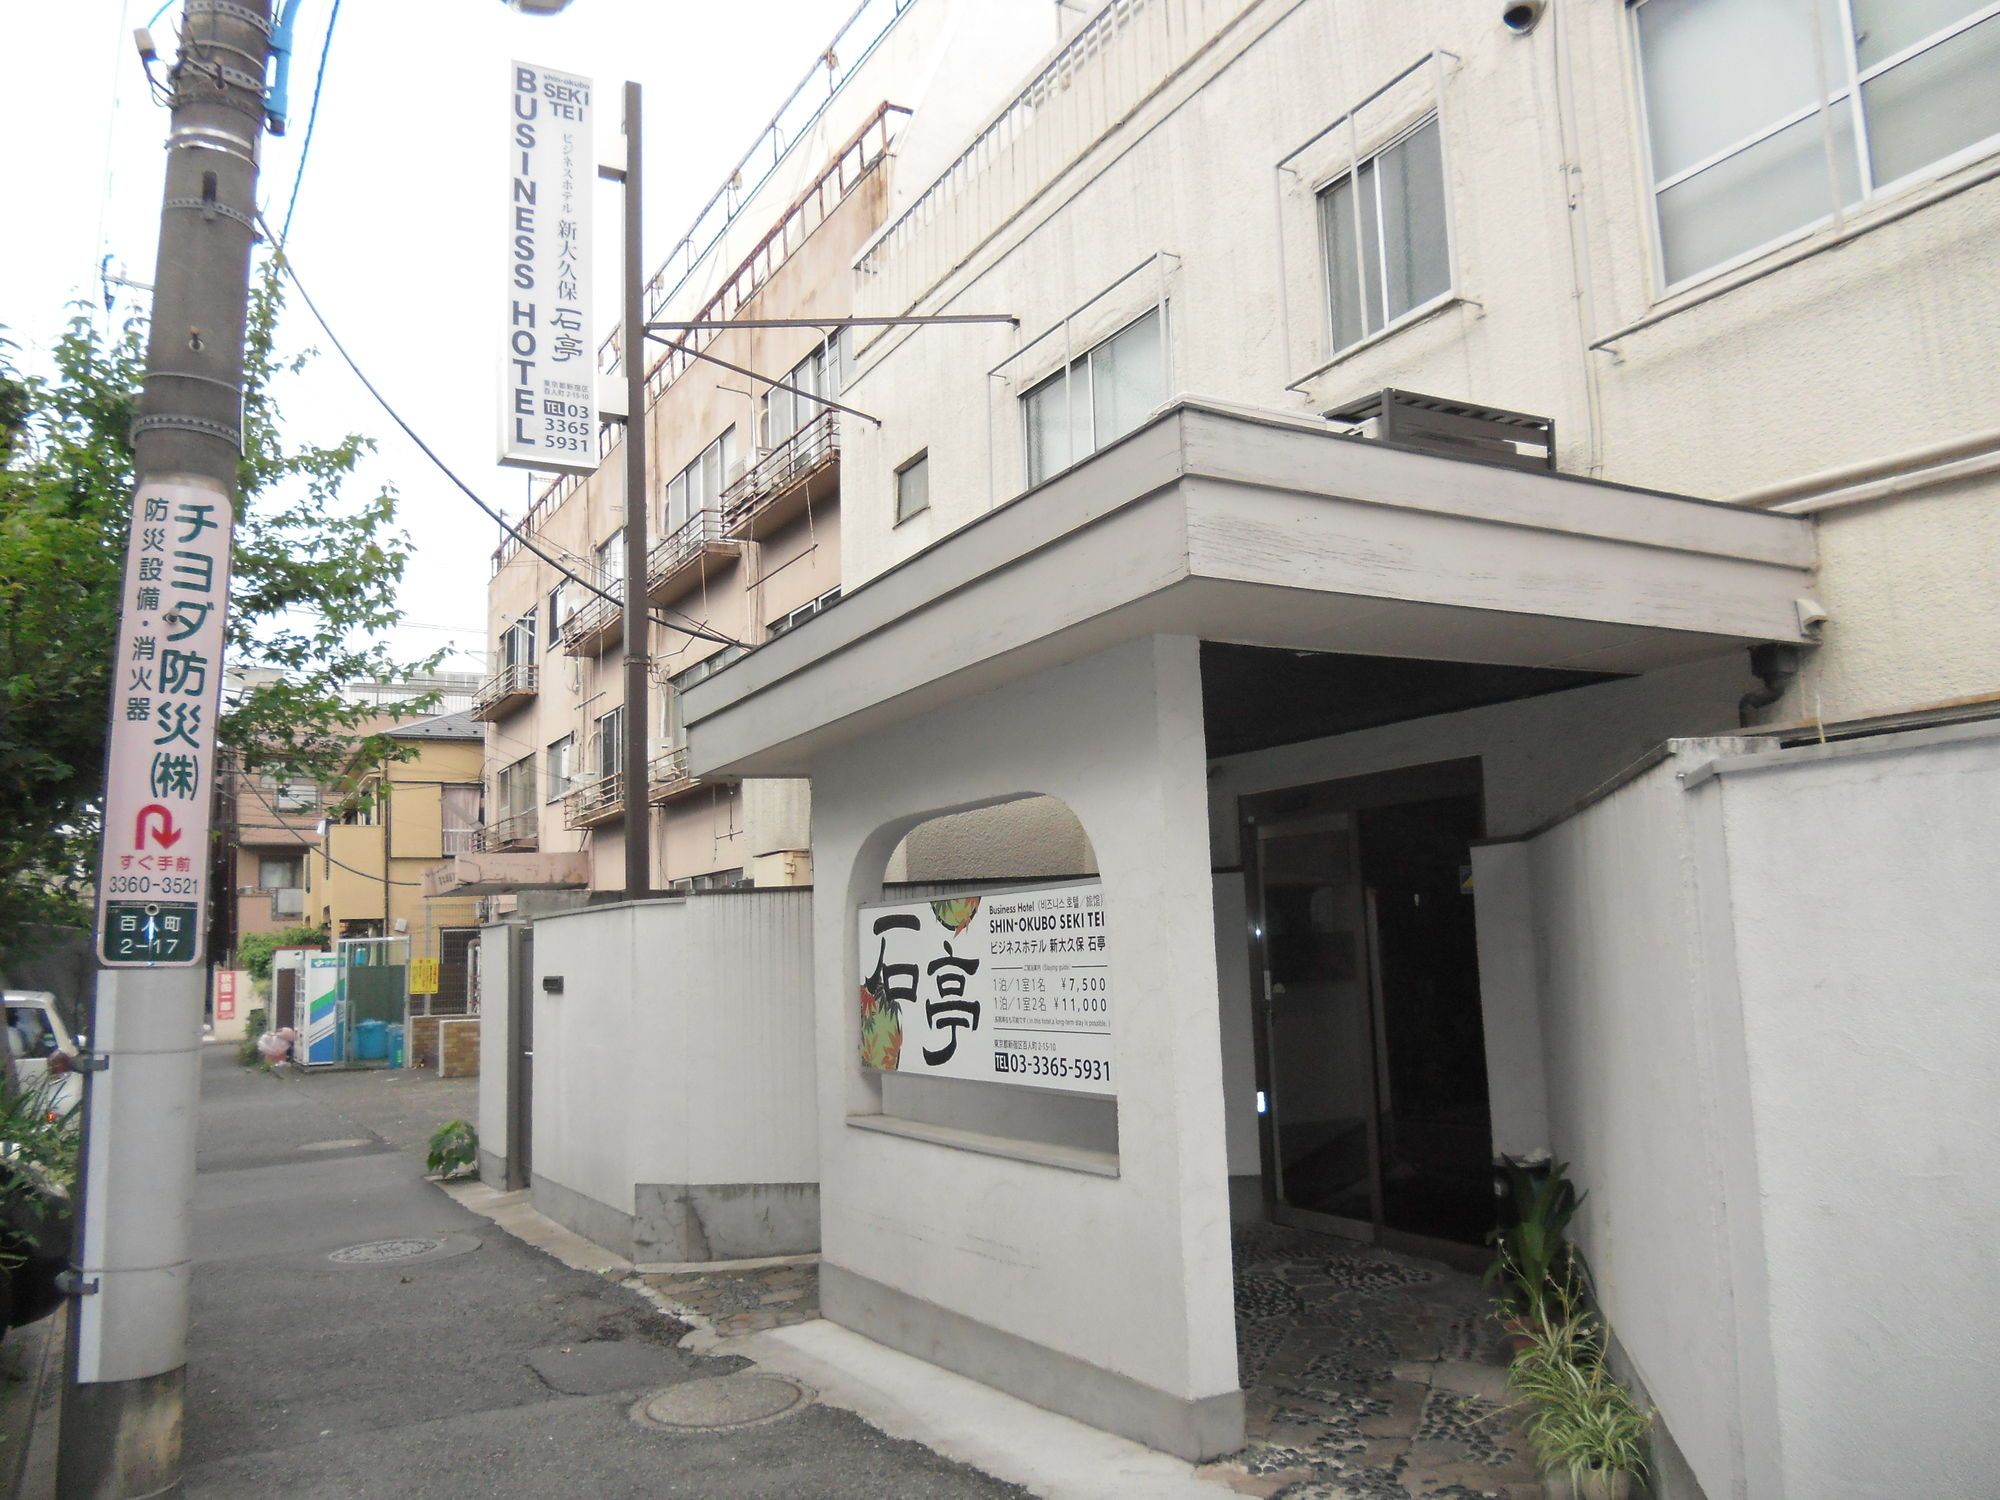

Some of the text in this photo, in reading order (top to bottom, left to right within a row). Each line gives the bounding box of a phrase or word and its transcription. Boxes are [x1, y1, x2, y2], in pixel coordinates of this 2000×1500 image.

[543, 83, 590, 106] SEKI
[549, 101, 583, 122] TEI
[512, 67, 538, 446] BUSINESS HOTEL
[550, 132, 583, 362] ビジネスホテル 新大久保 石亭
[545, 400, 589, 419] TEL 03
[544, 417, 589, 435] 3365
[544, 434, 588, 452] 5931
[126, 497, 170, 722] 防災設備・消火器
[120, 854, 192, 873] すぐ手前
[109, 876, 198, 895] 3360-3521
[989, 904, 1016, 915] Business
[1017, 901, 1035, 913] Hotel
[120, 915, 182, 932] 百人町
[989, 911, 1105, 934] SHIN-OKUBO SEKI TEI
[119, 938, 179, 955] 2-17
[990, 935, 1106, 955] ビジネスホテル 新大久保 石亭
[864, 913, 982, 1067] 石亭
[995, 1053, 1110, 1081] TEL 03-3365-5931
